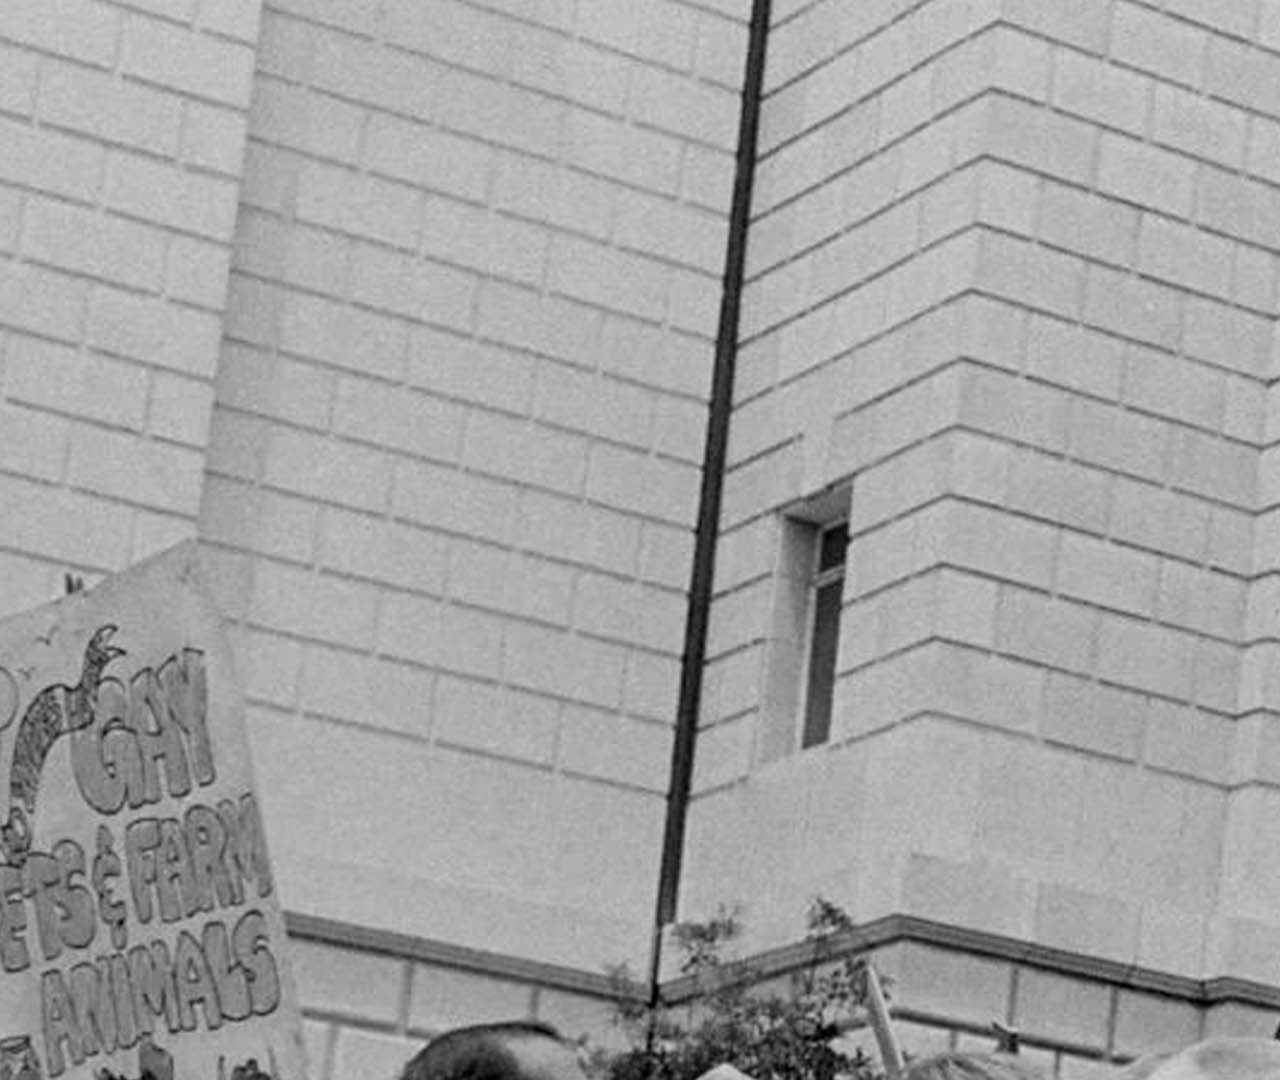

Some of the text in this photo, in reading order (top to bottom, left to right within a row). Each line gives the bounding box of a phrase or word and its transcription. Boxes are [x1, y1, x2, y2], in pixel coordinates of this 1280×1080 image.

[70, 646, 217, 815] GAY
[125, 792, 274, 924] FARM
[41, 909, 281, 1079] ANIMALS
